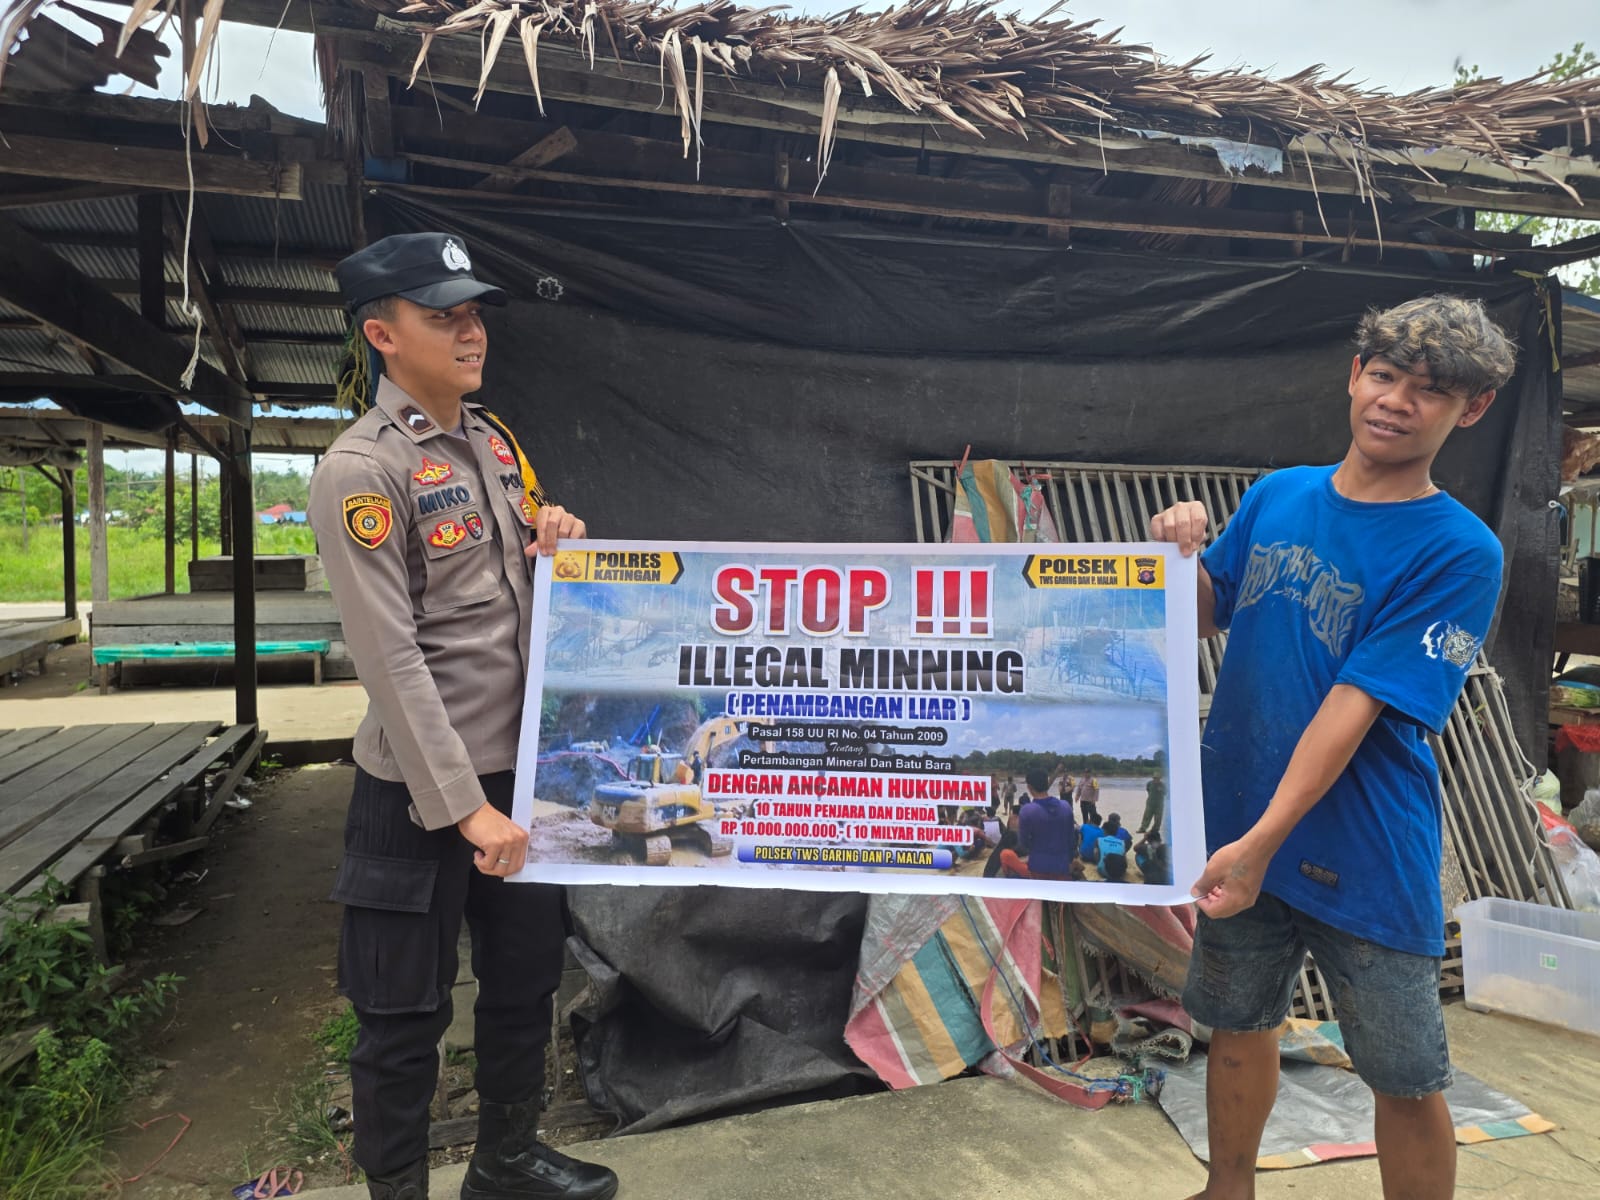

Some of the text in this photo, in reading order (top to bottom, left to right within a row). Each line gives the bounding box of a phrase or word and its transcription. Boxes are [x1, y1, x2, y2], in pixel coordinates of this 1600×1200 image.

[418, 486, 470, 514] MIKO
[595, 552, 661, 569] POLRES
[1039, 558, 1117, 574] POLSEK
[594, 569, 661, 582] KATINGAN
[1039, 575, 1054, 585] TWS
[1078, 575, 1091, 585] DAN
[713, 565, 990, 636] STOP !!!
[678, 645, 1024, 694] ILLEGAL MINNING
[741, 693, 903, 719] PENAMBANGAN
[908, 696, 957, 720] LIAR
[752, 726, 944, 741] Pasal 158 UU RI No. 04 Tahun 2009
[743, 754, 952, 771] Pertambangan Mineral Dan Batu Bara
[707, 773, 987, 802] DENGAN ANCAMAN HUKUMAN
[756, 802, 936, 822] 10 TAHUN PENJARA DAN DENDA
[721, 821, 738, 835] RP.
[740, 821, 844, 839] 10.000.000.000,-
[853, 825, 868, 840] 10
[870, 825, 914, 841] MILYAR
[917, 826, 963, 843] RUPIAH
[755, 846, 933, 865] POLSEK TWS GARING DAN P. MALAN
